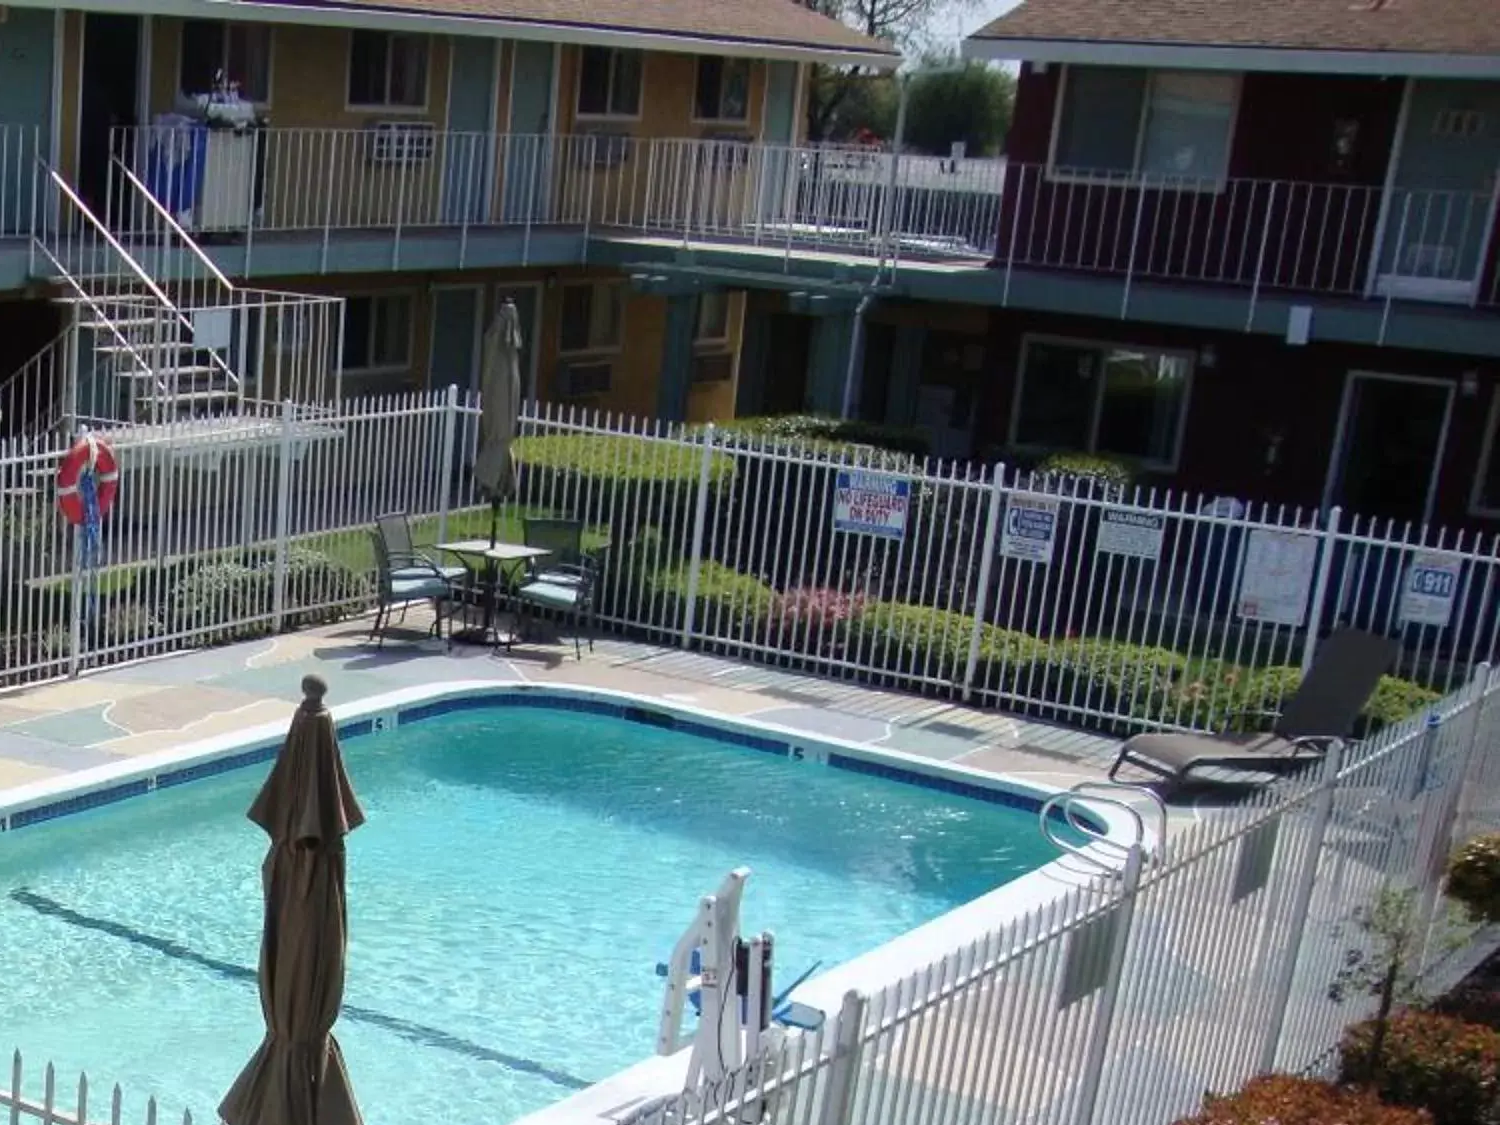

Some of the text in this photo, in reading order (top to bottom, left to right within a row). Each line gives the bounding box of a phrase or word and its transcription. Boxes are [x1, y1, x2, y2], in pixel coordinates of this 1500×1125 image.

[837, 489, 850, 505] NO
[1424, 571, 1452, 593] 911
[793, 747, 805, 761] 5
